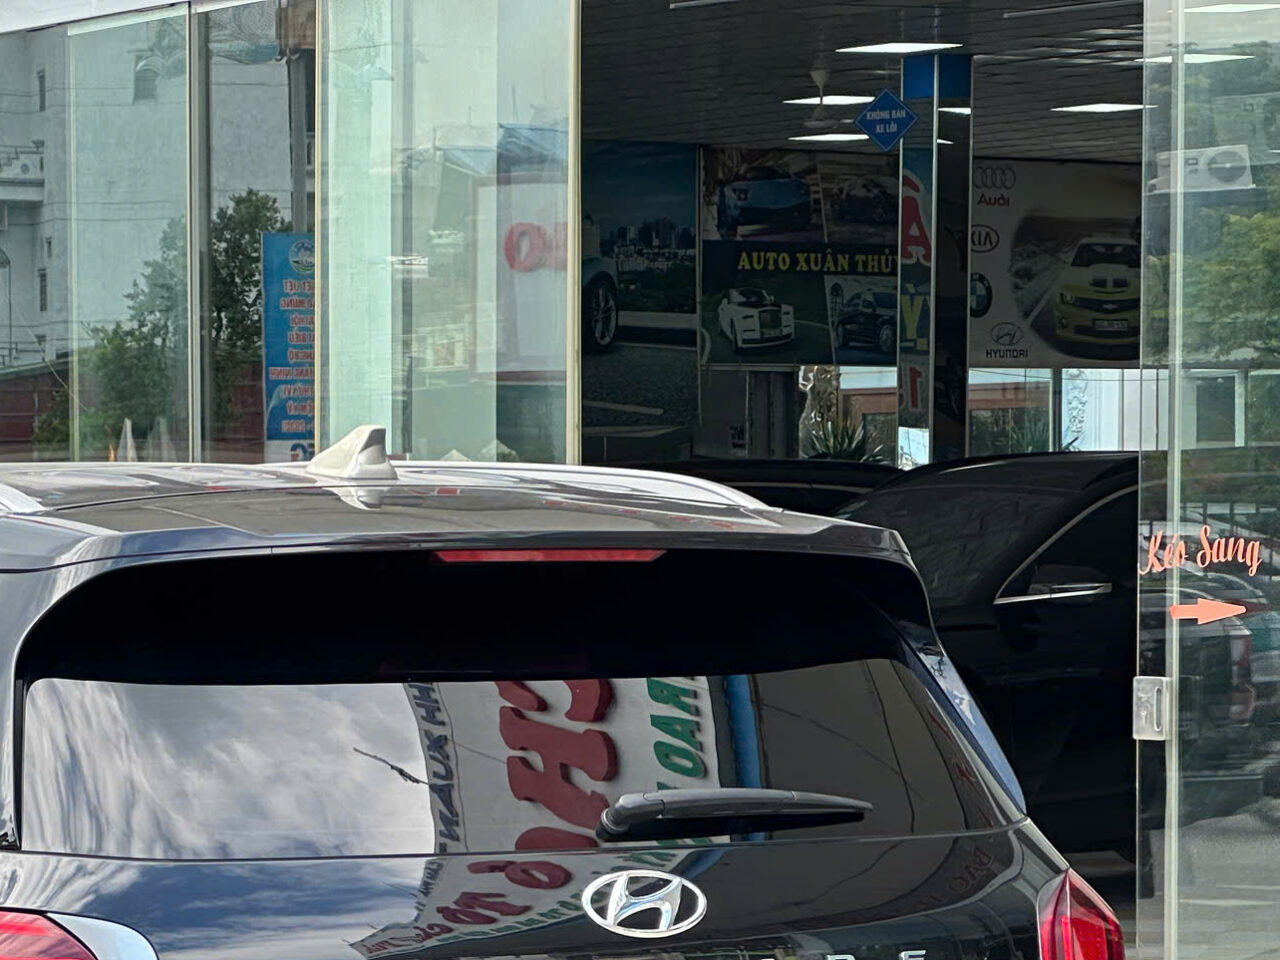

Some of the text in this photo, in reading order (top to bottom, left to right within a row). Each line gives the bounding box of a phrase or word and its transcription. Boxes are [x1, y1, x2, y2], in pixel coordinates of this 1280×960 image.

[976, 193, 1010, 207] Audi
[737, 247, 899, 273] AUTO XUÂN THỦ
[985, 349, 1028, 359] HYUNDAI
[1139, 524, 1262, 577] Kéo Sang
